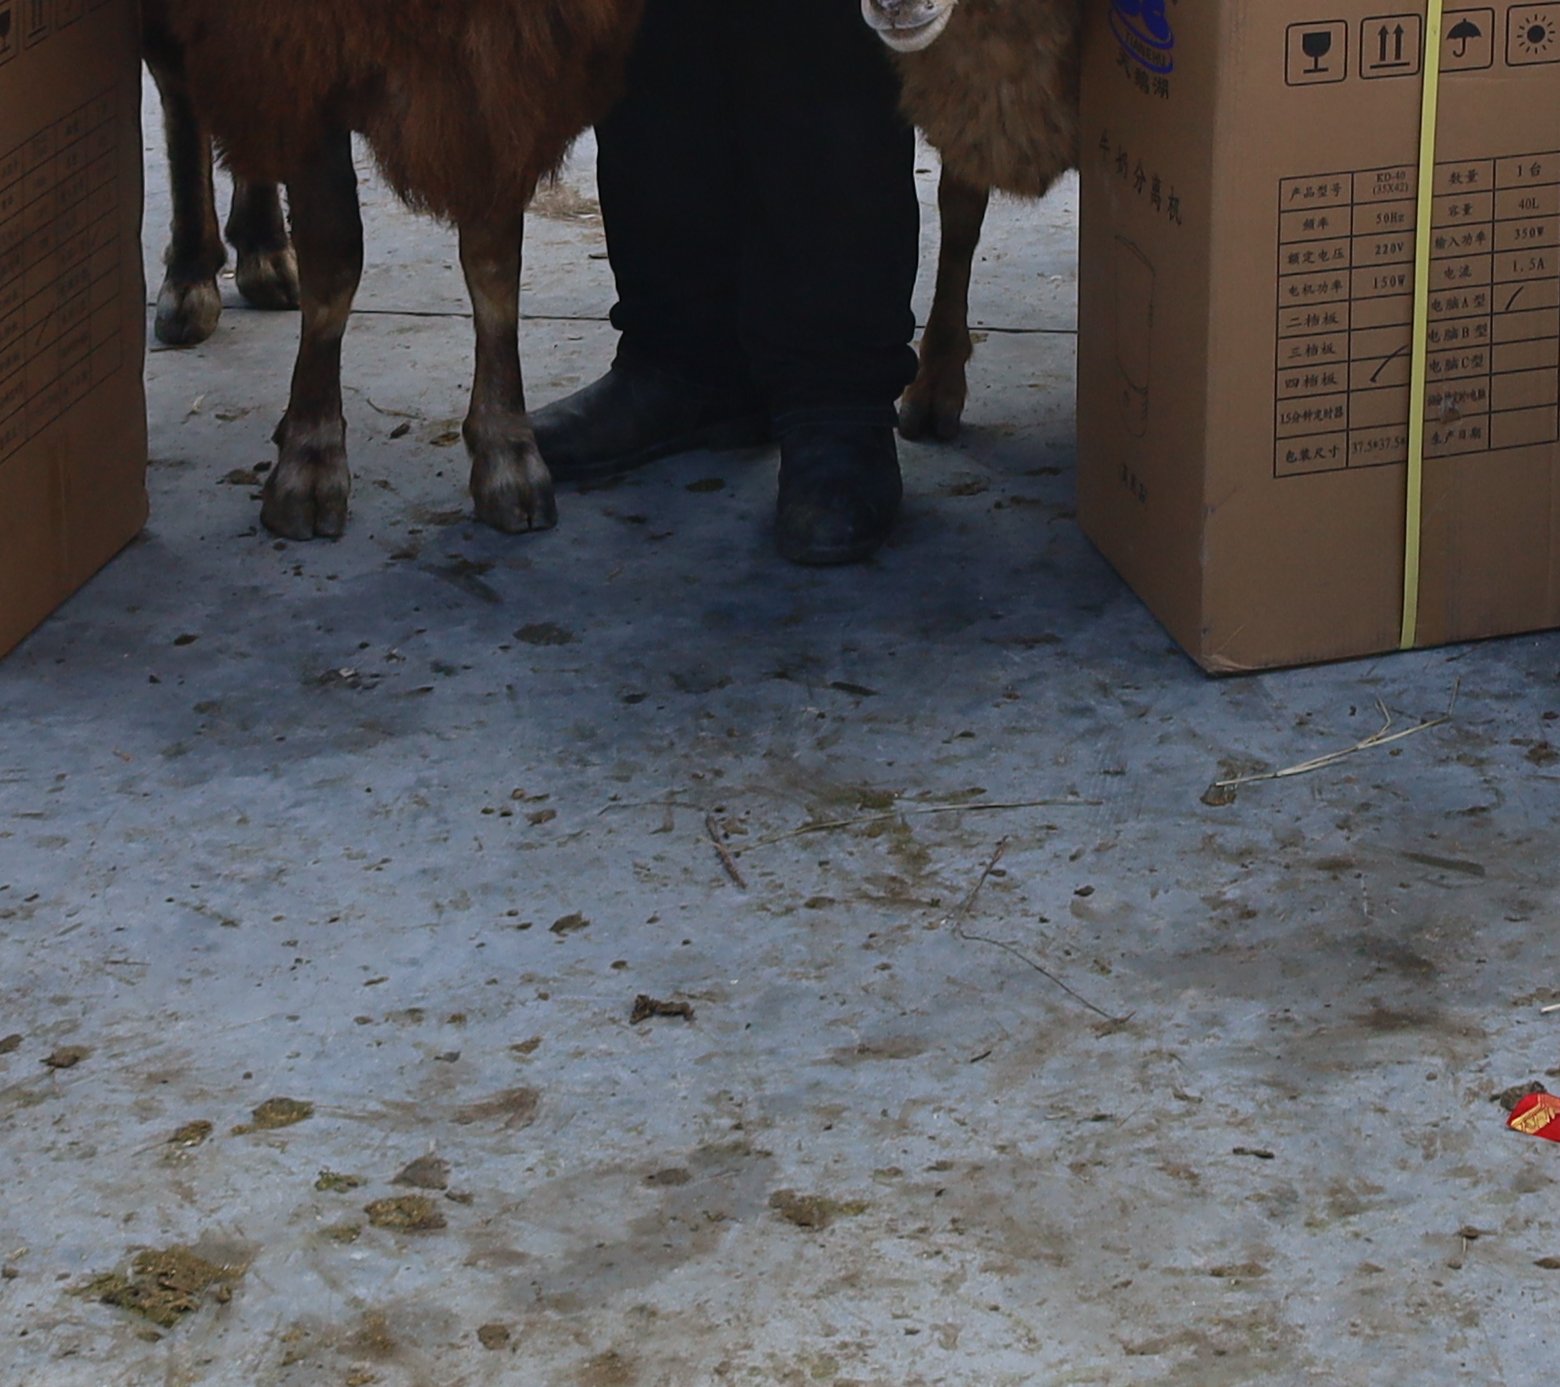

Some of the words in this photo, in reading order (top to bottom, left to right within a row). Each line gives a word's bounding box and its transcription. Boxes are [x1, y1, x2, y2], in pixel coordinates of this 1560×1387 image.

[1449, 169, 1479, 185] 数量
[1290, 184, 1342, 202] 产品型号
[1448, 203, 1473, 217] 容量
[1518, 198, 1539, 210] 40L
[1376, 212, 1405, 225] 50Hz
[1434, 230, 1487, 249] 输入功率
[1514, 227, 1545, 240] 350W
[1287, 248, 1345, 265] 额定电压
[1375, 242, 1404, 255] 220V
[1443, 265, 1472, 279] 电流
[1288, 280, 1343, 298] 电机功率
[1373, 275, 1405, 290] 150W
[1286, 312, 1339, 328] 二档板
[1288, 343, 1336, 359] 三档板
[1284, 374, 1337, 389] 四档板
[1431, 428, 1482, 446] 生产日期
[1285, 445, 1341, 464] 包装尺寸
